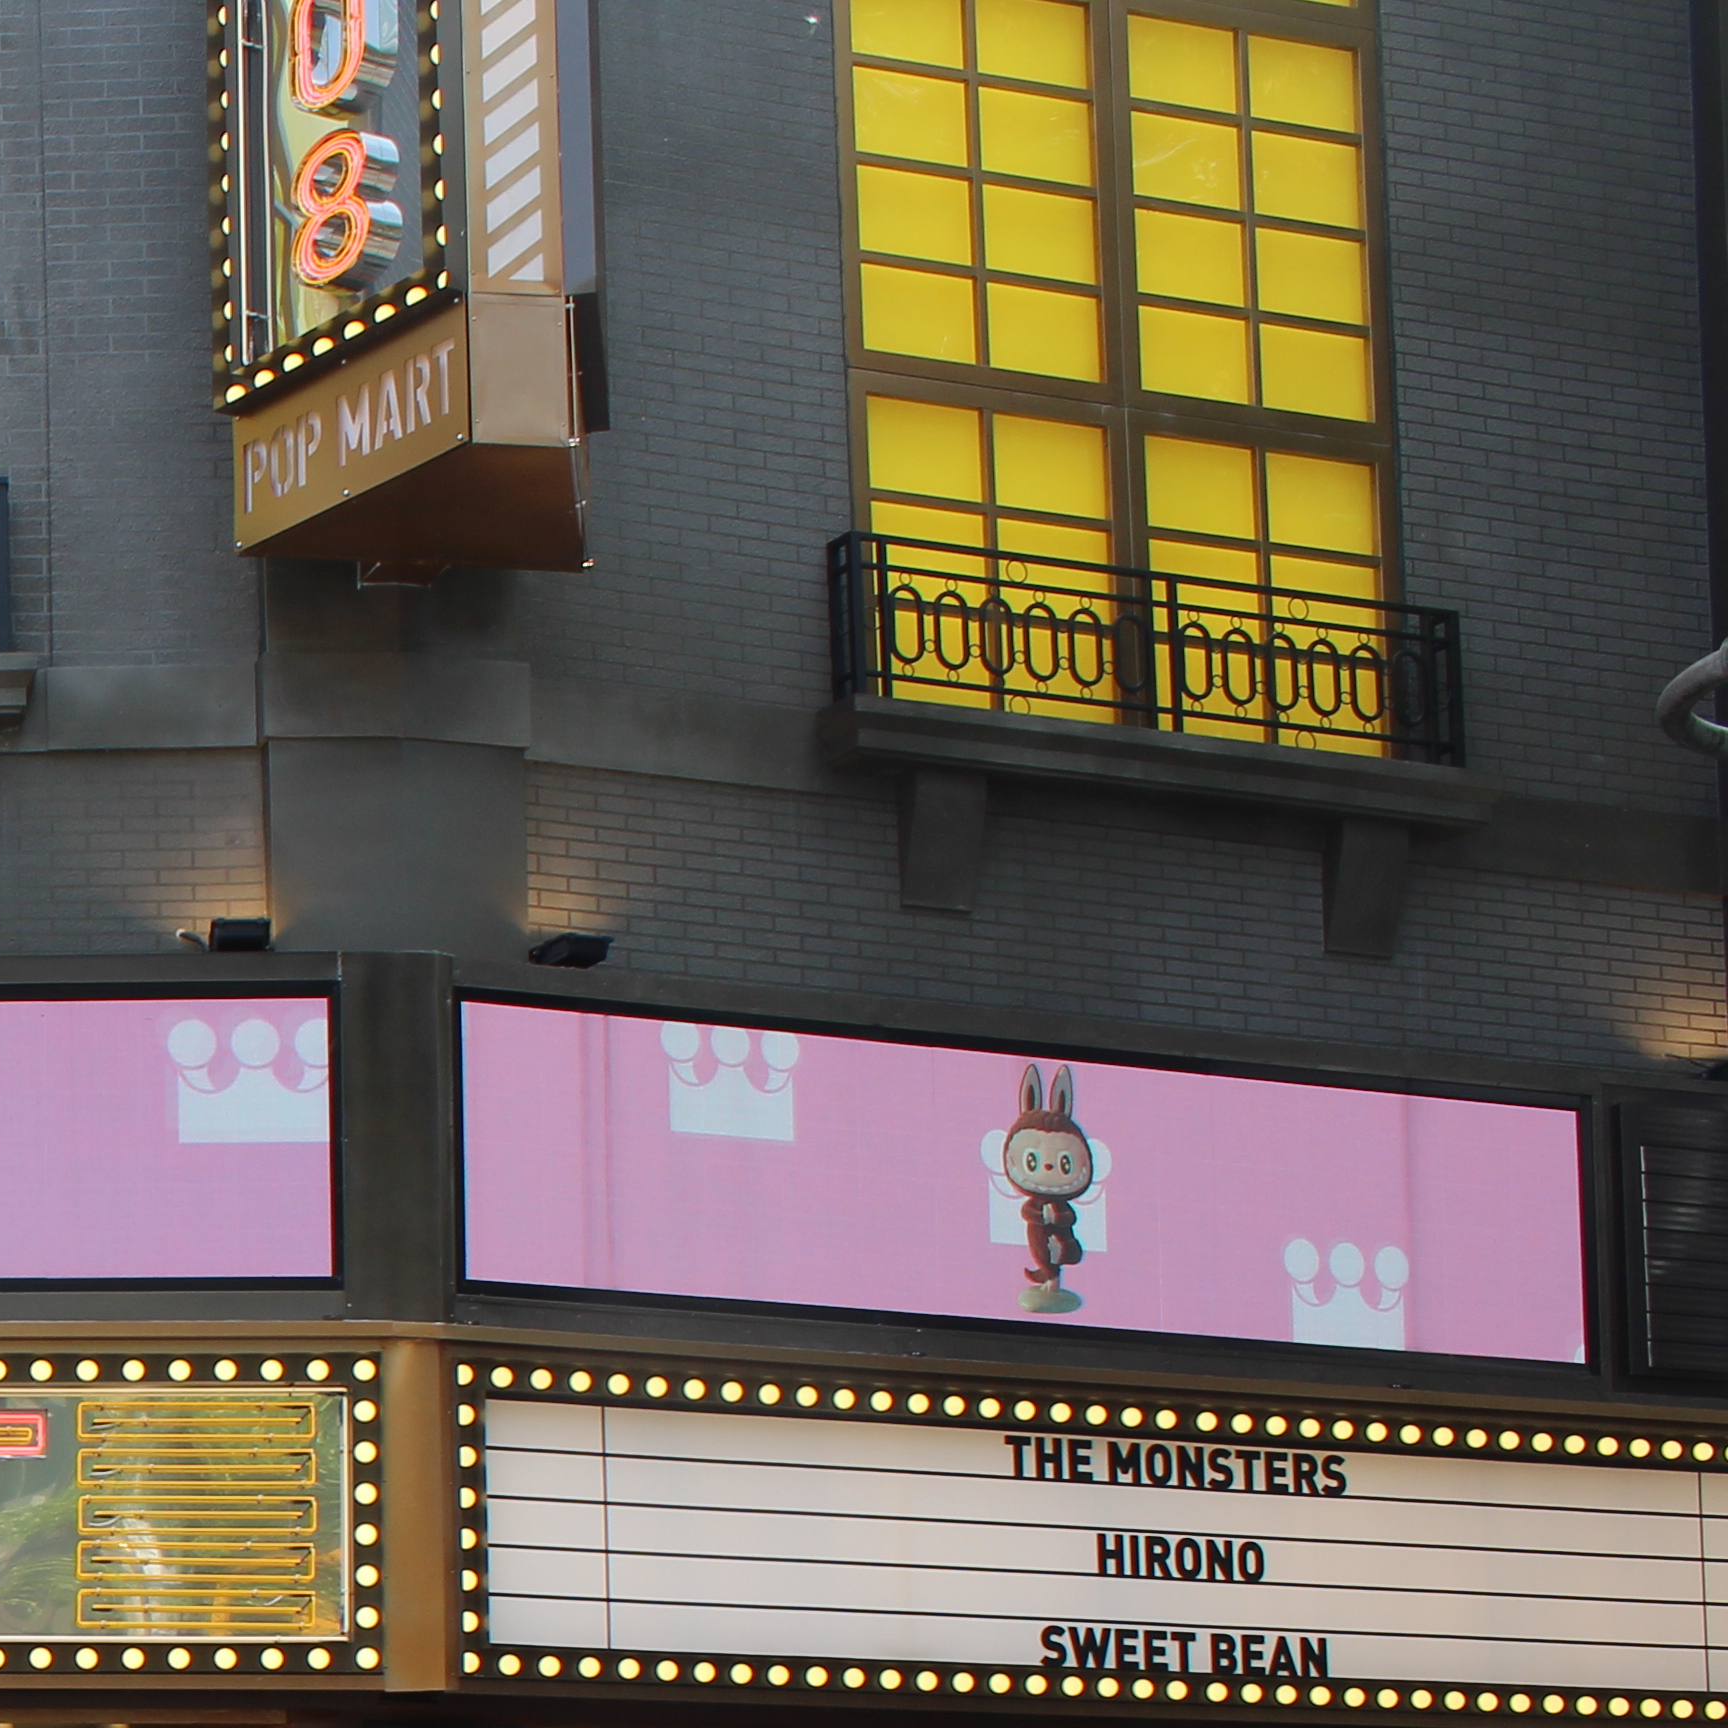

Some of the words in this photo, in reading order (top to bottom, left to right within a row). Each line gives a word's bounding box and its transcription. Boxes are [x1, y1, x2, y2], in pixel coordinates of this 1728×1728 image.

[242, 410, 322, 514] POP
[337, 338, 456, 466] MART
[1004, 1434, 1095, 1484] THE
[1105, 1440, 1348, 1500] MONSTERS
[1095, 1532, 1267, 1585] HIRONO
[1041, 1625, 1198, 1675] SWEET
[1208, 1631, 1331, 1681] BEAN
